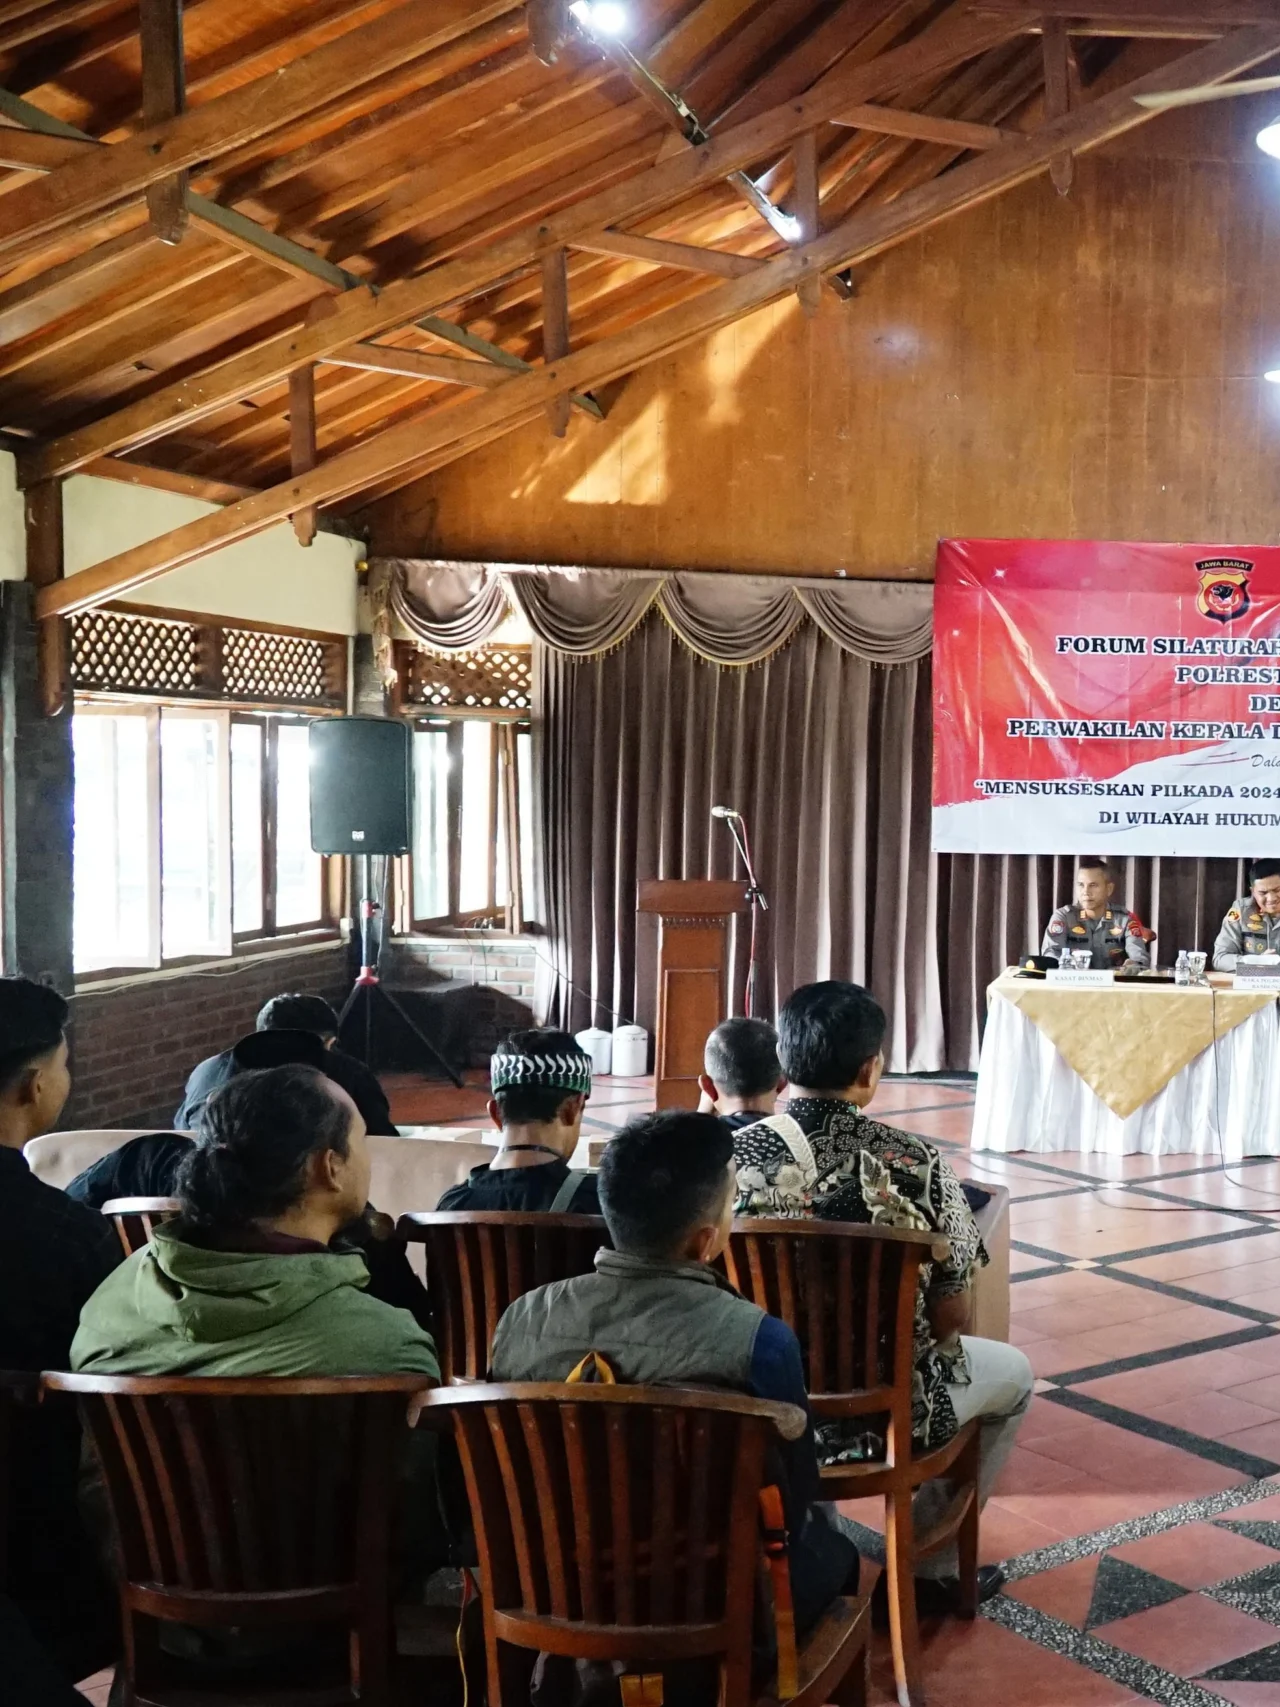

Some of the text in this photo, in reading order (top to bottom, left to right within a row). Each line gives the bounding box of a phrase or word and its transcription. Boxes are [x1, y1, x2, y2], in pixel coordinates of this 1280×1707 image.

[1200, 560, 1250, 570] JAWA BARAT
[1057, 637, 1145, 653] FORUM
[1008, 720, 1164, 738] PERWAKILAN
[1172, 723, 1265, 739] KEPALA
[975, 781, 1144, 797] “MENSUKSESKAN
[1151, 784, 1235, 798] PILKADA
[1099, 811, 1120, 824] DI
[1126, 812, 1209, 826] WILAYAH
